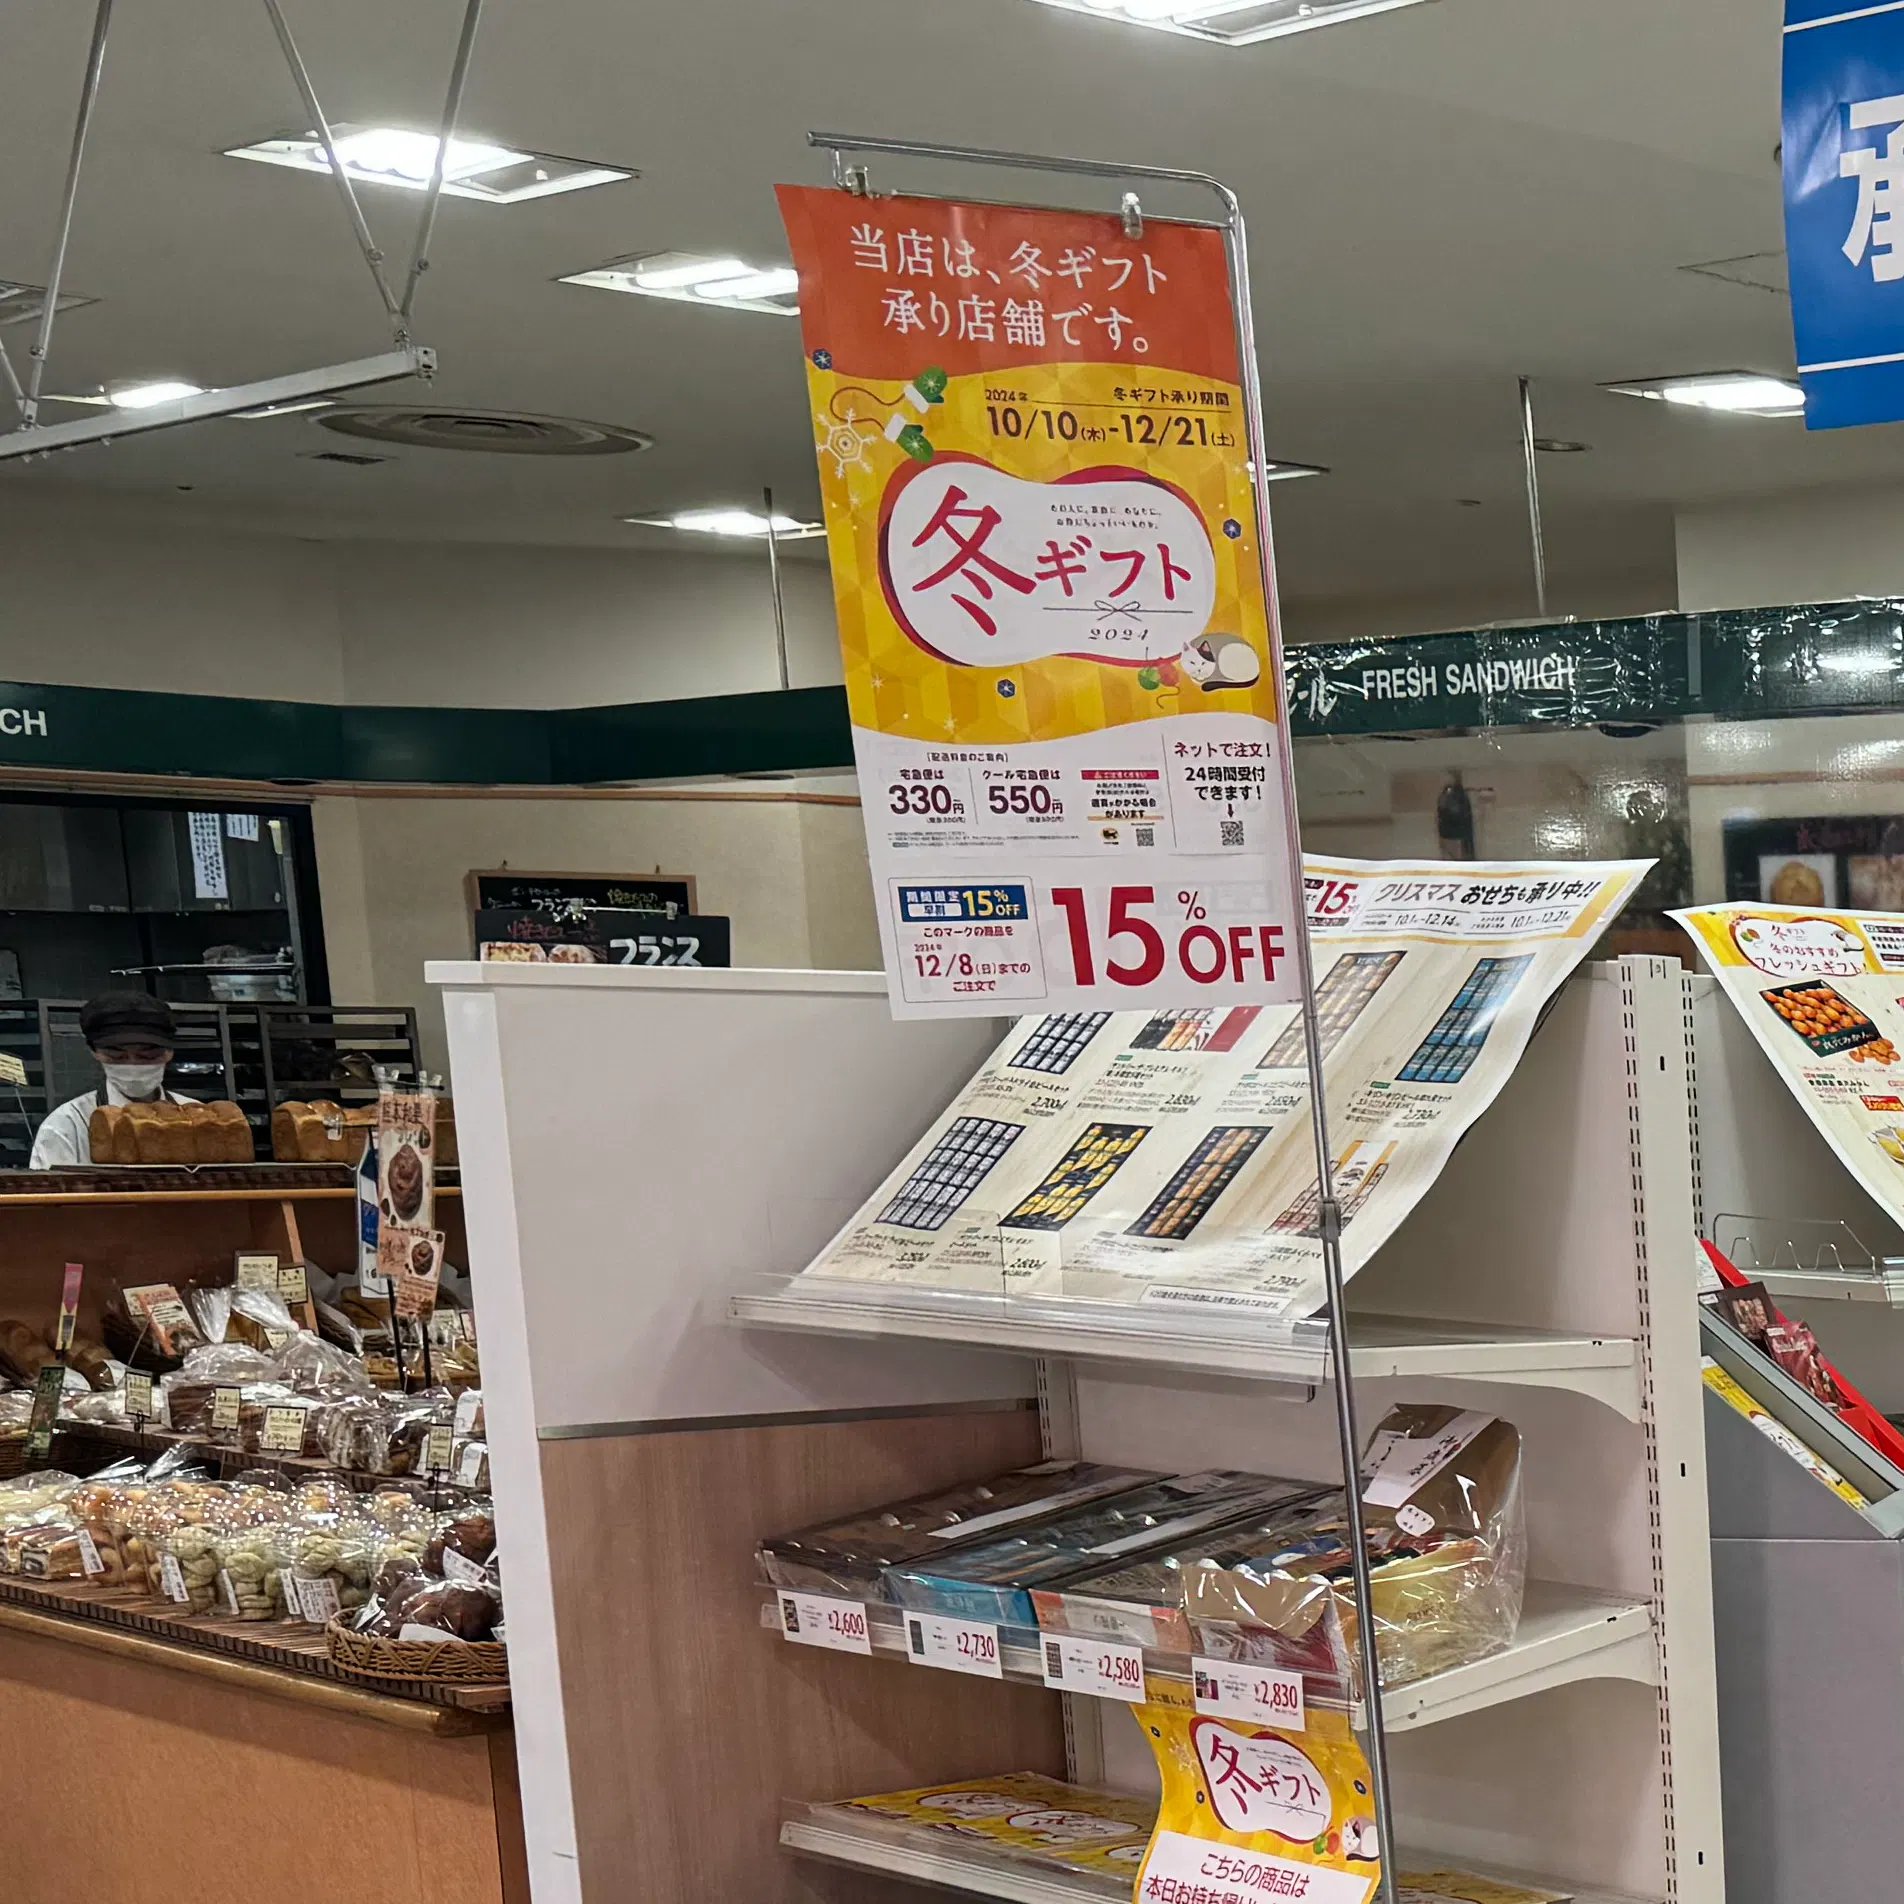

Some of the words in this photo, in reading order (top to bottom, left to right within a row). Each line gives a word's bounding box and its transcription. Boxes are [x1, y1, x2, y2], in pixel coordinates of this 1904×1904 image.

[849, 222, 1168, 295] 当店は、冬ギフト
[881, 287, 1149, 353] 承り店舗です。
[911, 484, 1193, 637] 冬ギフト
[1363, 666, 1438, 700] FRESH
[1446, 654, 1577, 696] SANDWICH
[0, 707, 48, 737] CH
[1185, 766, 1266, 784] 24時間受付
[888, 784, 965, 815] 330円
[988, 784, 1064, 815] 550円
[1375, 882, 1464, 902] クリスマス
[1051, 885, 1166, 987] 15
[1178, 926, 1286, 984] OFF
[1210, 1732, 1321, 1815] 冬ギフト
[1200, 1853, 1311, 1898] こちらの商品は
